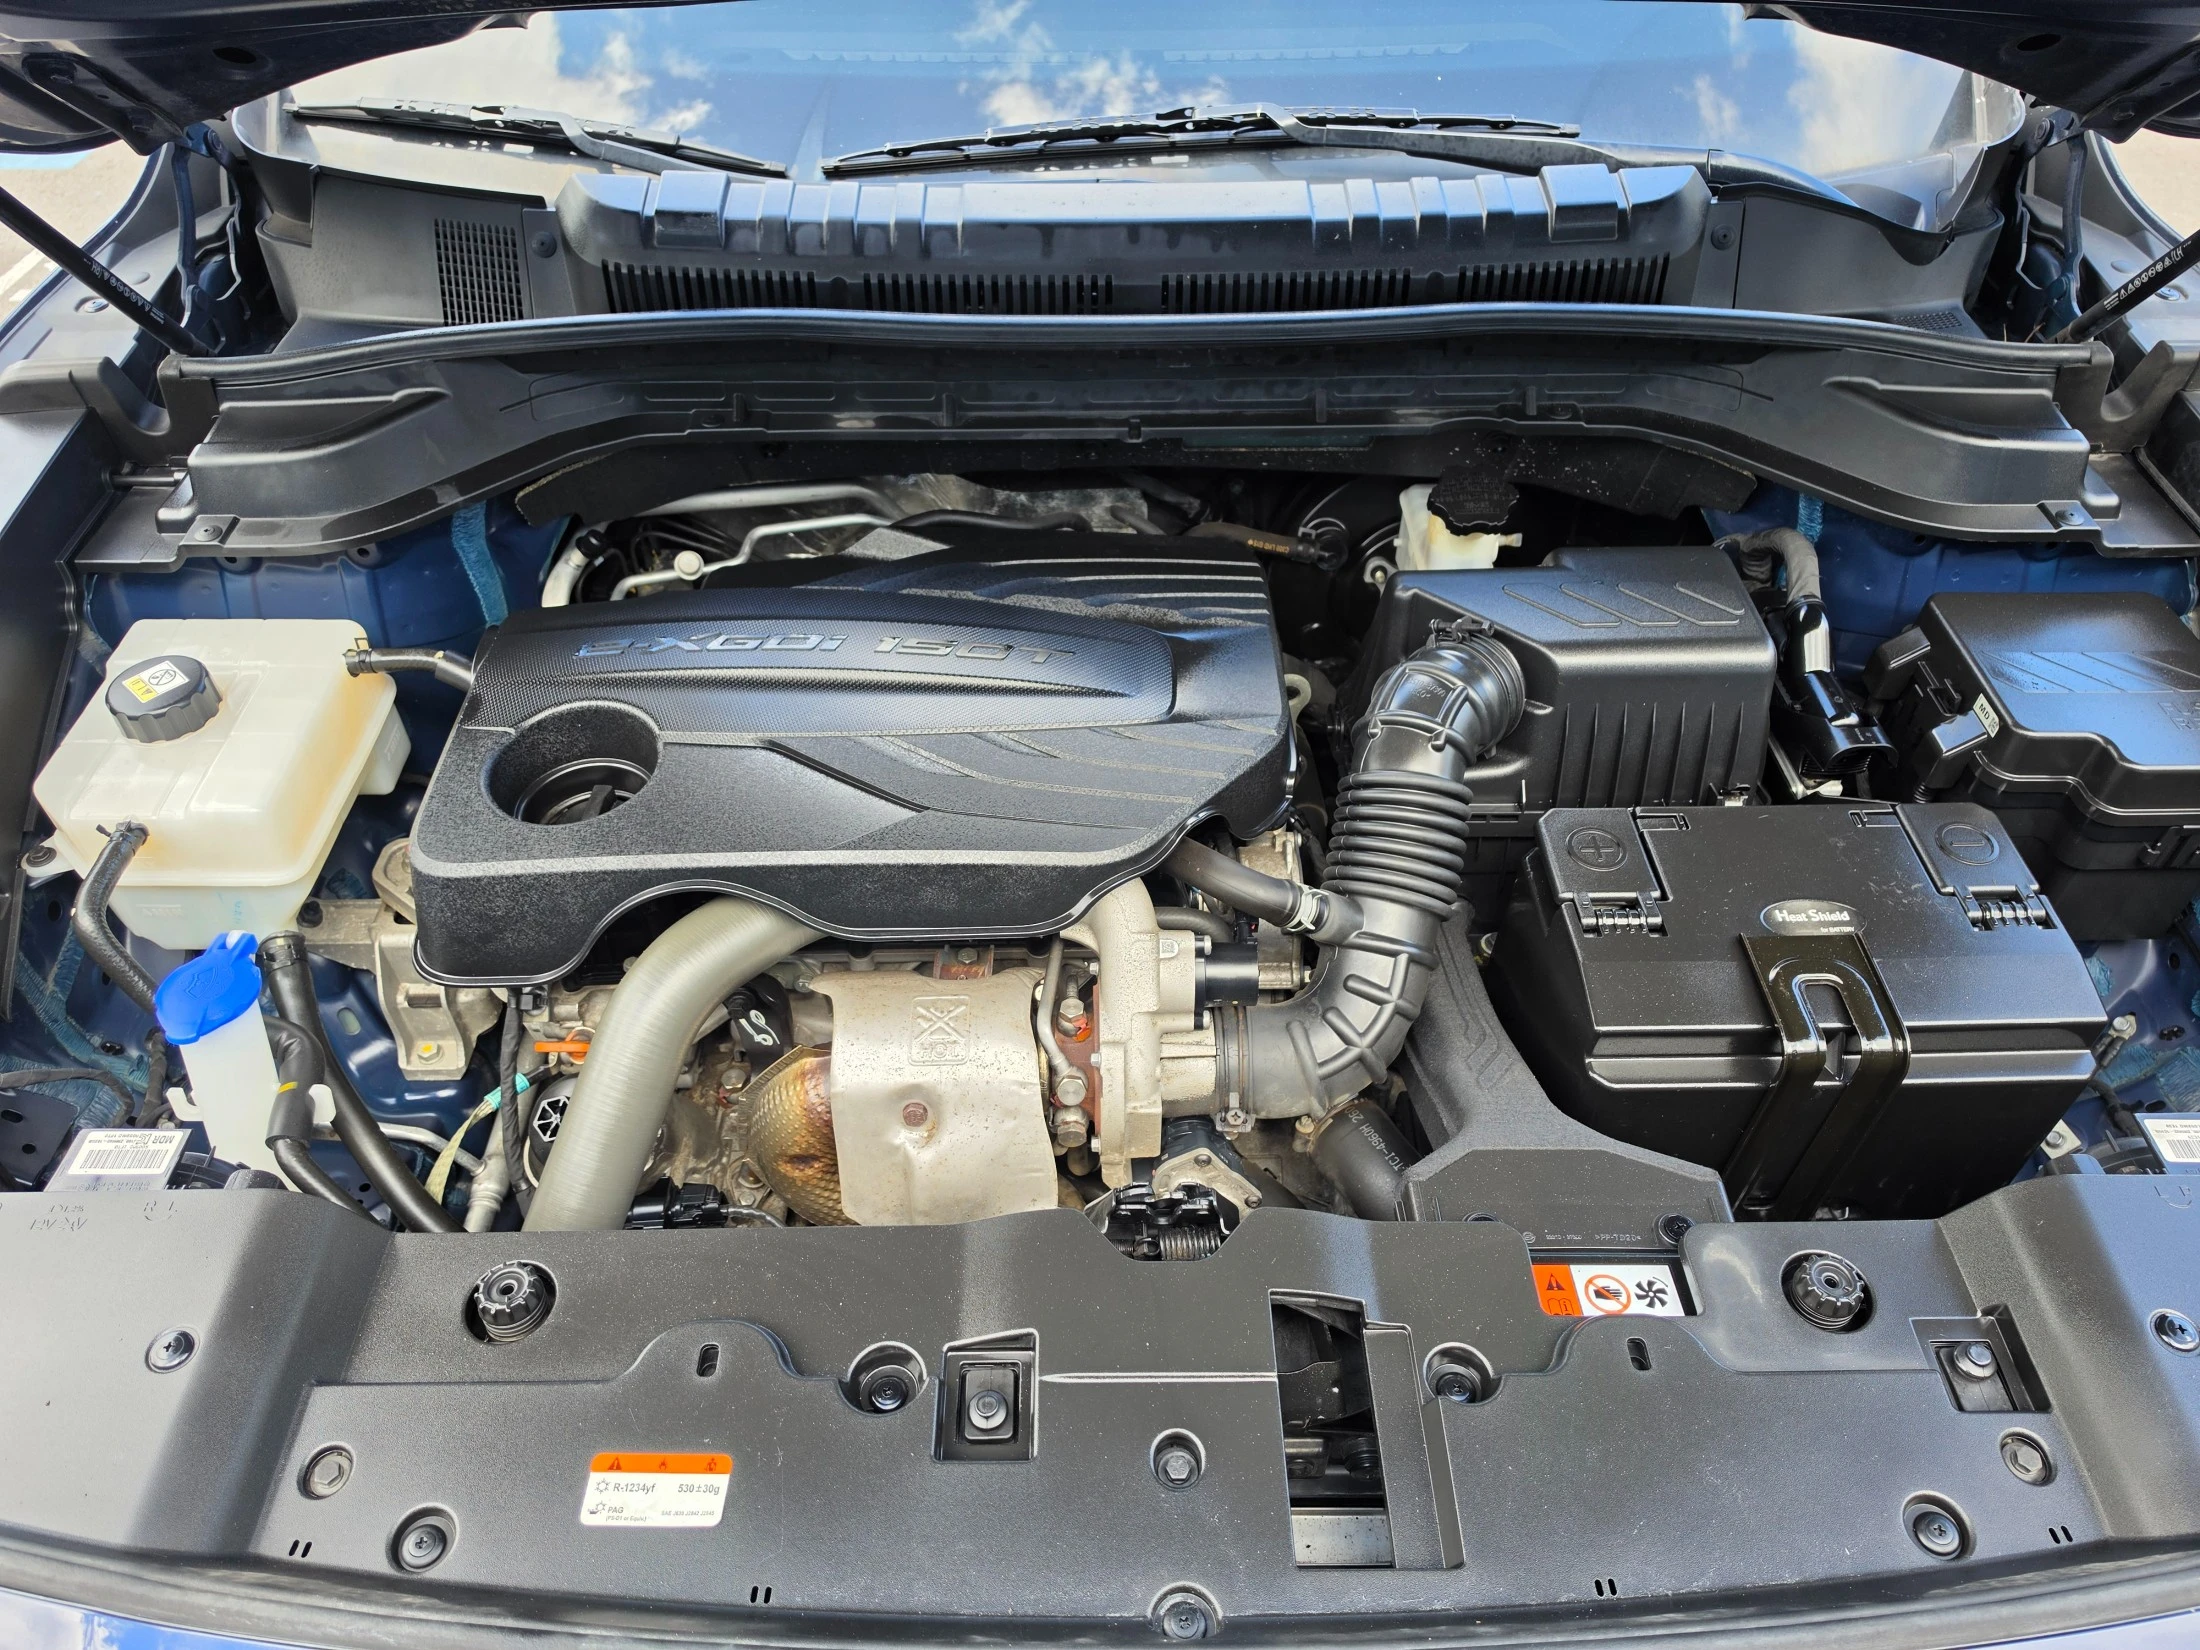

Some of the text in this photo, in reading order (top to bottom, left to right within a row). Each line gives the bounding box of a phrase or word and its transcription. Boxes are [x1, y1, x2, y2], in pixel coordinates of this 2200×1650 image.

[874, 636, 1076, 664] 150T
[1775, 909, 1851, 922] Heat Shield
[612, 1482, 720, 1496] R-1234yf 530±30g
[607, 1506, 624, 1514] PAG
